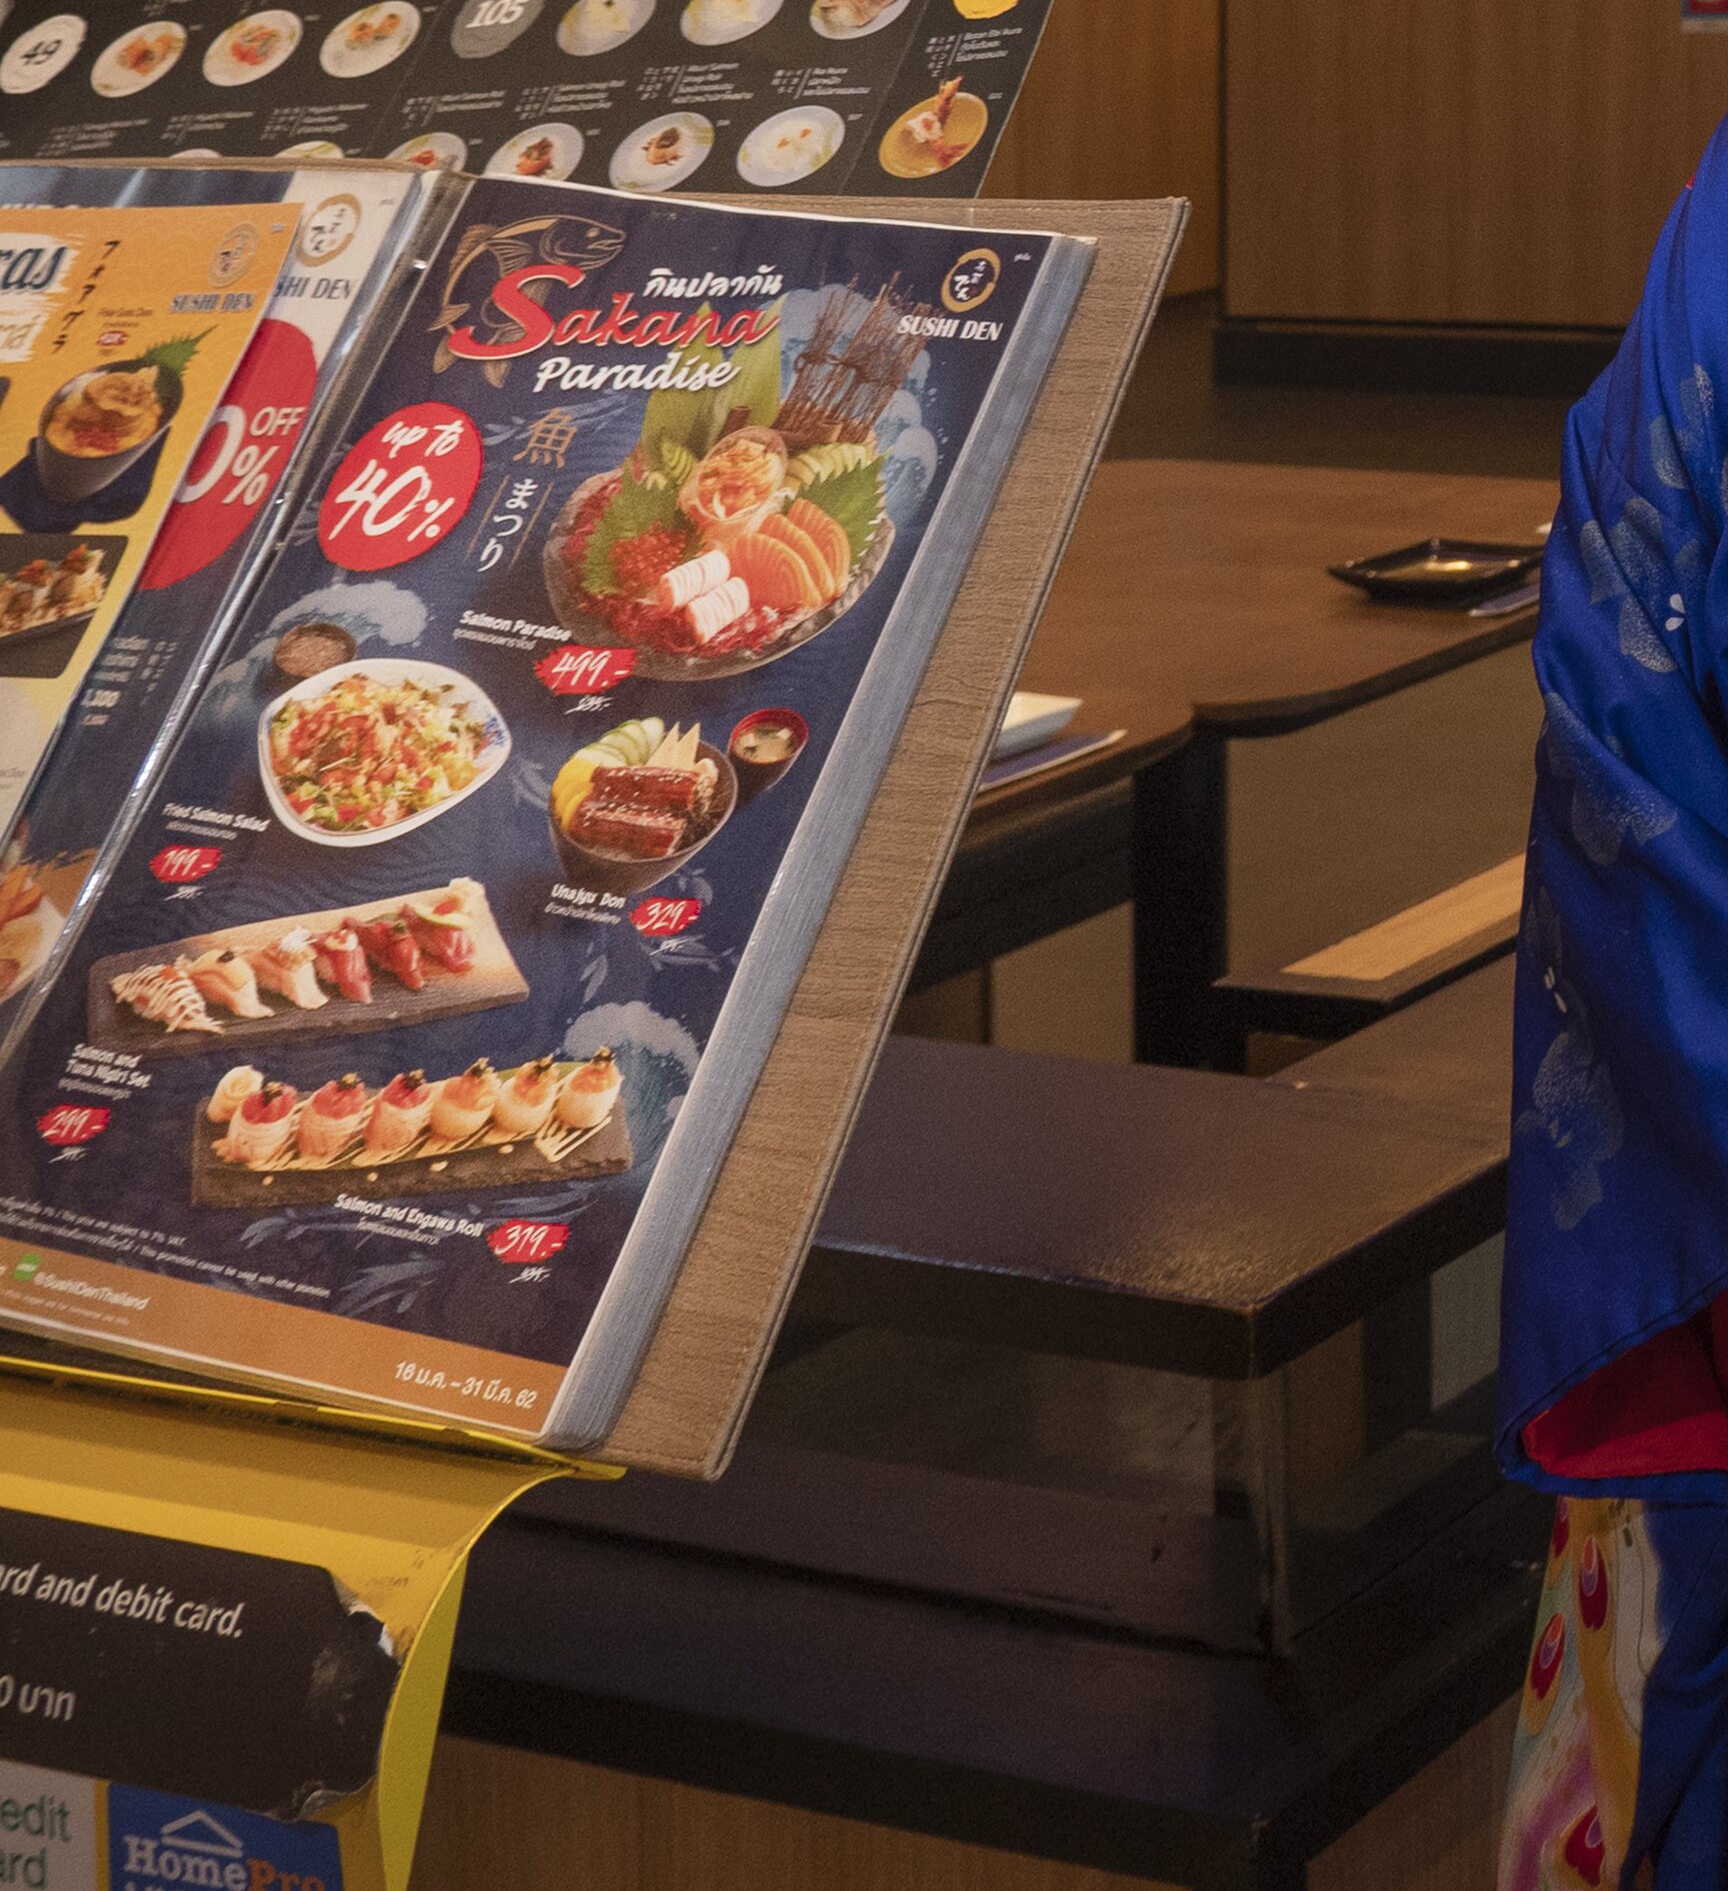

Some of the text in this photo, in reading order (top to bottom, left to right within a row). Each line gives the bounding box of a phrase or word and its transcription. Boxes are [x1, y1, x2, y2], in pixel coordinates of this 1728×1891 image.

[21, 38, 62, 66] 49
[642, 264, 783, 298] กินปลากัน
[448, 263, 781, 361] Sakana
[898, 313, 1004, 342] SUSHI DEN
[532, 351, 742, 393] Paradise
[249, 406, 303, 438] OFF
[381, 419, 465, 460] up to
[512, 409, 578, 468] 魚
[328, 458, 456, 542] 40%
[477, 478, 539, 573] まつり
[459, 610, 573, 643] Salmon Paradise
[551, 649, 630, 691] 499.-
[159, 848, 214, 877] 199.-
[550, 882, 628, 910] Unajyu Don
[635, 900, 700, 931] 329.-
[40, 1107, 104, 1139] 299.-
[333, 1192, 487, 1239] Salmon and Engawa Roll
[493, 1224, 565, 1257] 319.-
[394, 1359, 417, 1382] 16
[413, 1366, 448, 1390] ม.ค.
[460, 1375, 486, 1398] 31
[514, 1387, 539, 1411] 62
[34, 1573, 100, 1609] and
[94, 1578, 175, 1625] debit
[173, 1601, 246, 1639] card.
[0, 1795, 71, 1843] edit
[123, 1833, 328, 1891] HomePro
